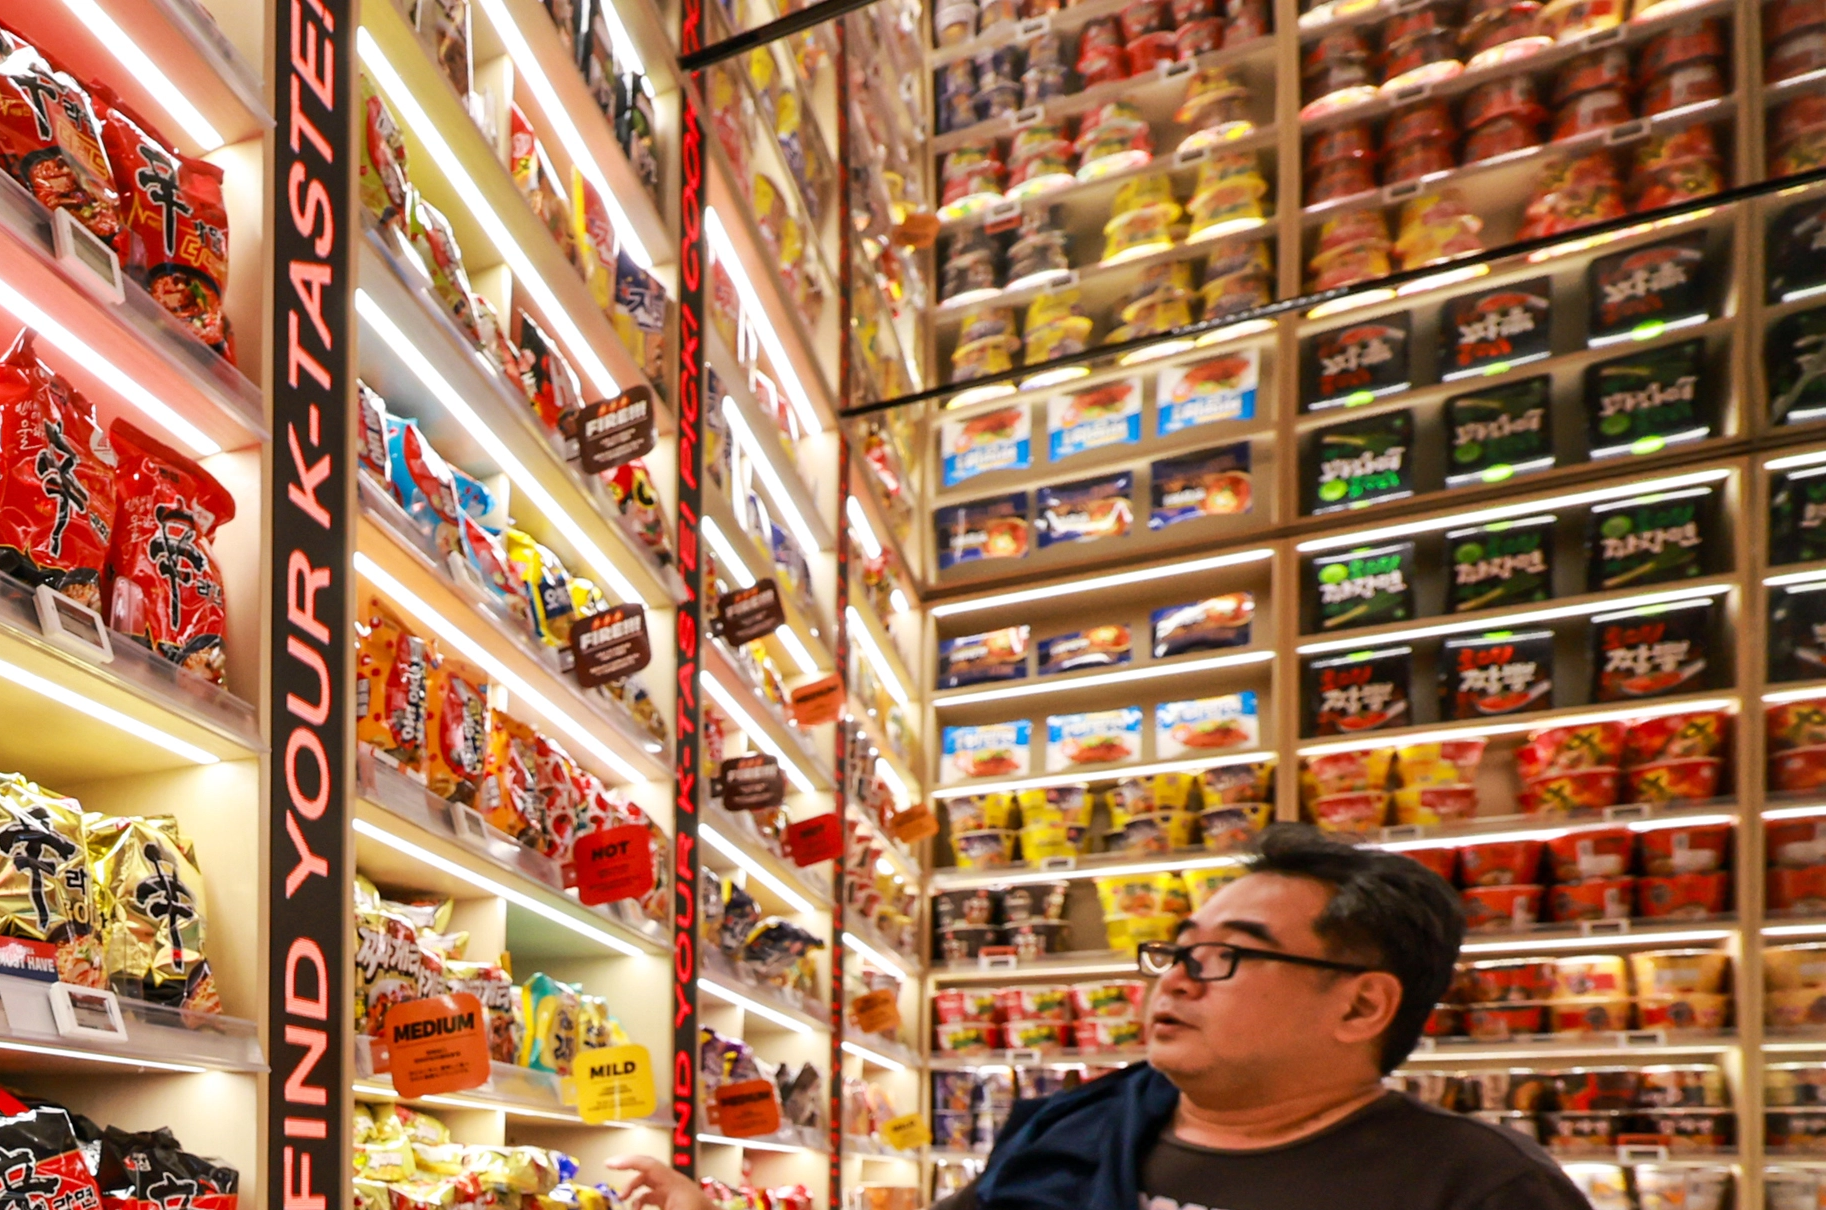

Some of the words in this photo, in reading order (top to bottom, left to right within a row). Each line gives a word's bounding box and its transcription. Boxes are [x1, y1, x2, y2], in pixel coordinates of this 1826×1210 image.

[283, 547, 332, 900] YOUR
[590, 839, 629, 863] HOT
[133, 840, 197, 975] 辛
[27, 955, 56, 973] HAVE
[393, 1011, 475, 1044] MEDIUM
[589, 1059, 637, 1081] MILD
